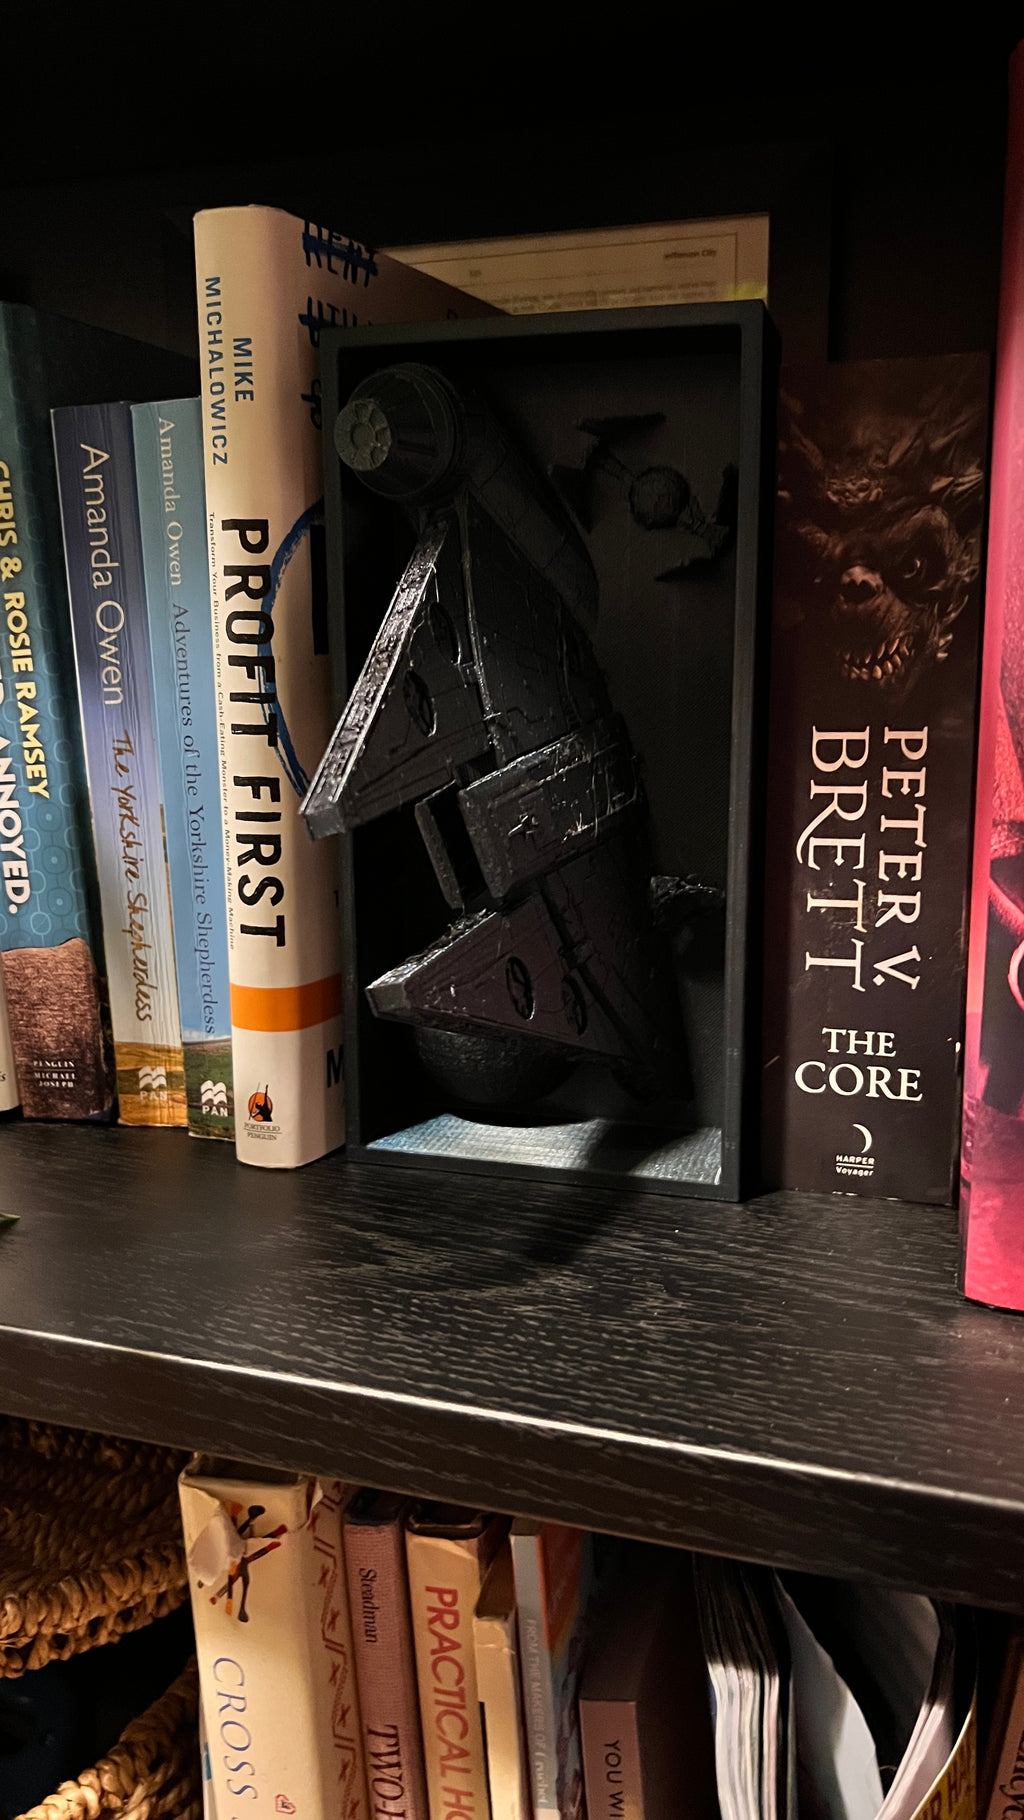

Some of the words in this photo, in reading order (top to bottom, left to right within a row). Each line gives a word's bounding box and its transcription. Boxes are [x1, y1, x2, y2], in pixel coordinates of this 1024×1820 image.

[204, 276, 228, 465] MICHALOWICZ
[233, 337, 254, 402] MIKE
[159, 417, 181, 513] Amanda
[80, 443, 120, 589] Amanda
[209, 511, 217, 568] Transform
[0, 556, 22, 583] &
[166, 521, 183, 586] Owen
[4, 591, 34, 673] ROSIE
[96, 600, 125, 705] Owen
[221, 519, 279, 748] PROFIT
[173, 604, 192, 727] Adventures
[15, 681, 50, 799] RAMSEY
[111, 729, 135, 778] The
[184, 735, 200, 759] of
[186, 763, 201, 796] the
[111, 784, 145, 884] Yorkshire
[190, 806, 210, 905] Yorkshire
[796, 725, 870, 992] BRETT
[875, 726, 928, 928] PETER
[233, 776, 286, 947] FIRST
[121, 890, 158, 1022] Shepherdess
[195, 912, 218, 1034] Shepherdess
[872, 945, 922, 990] V.
[33, 1060, 75, 1068] PENGUIN
[822, 1027, 897, 1057] THE
[34, 1072, 76, 1080] MICHAEL
[139, 1090, 167, 1101] PAN
[794, 1061, 923, 1102] CORE
[202, 1105, 228, 1117] PAN
[244, 1121, 281, 1132] PORTFOLIO
[247, 1132, 278, 1141] PENGUIN
[836, 1155, 875, 1165] HARPER
[836, 1165, 874, 1177] Voyager
[360, 1567, 380, 1643] Steadman
[425, 1585, 473, 1778] PRACTICAL
[213, 1657, 258, 1799] CROSS
[604, 1740, 622, 1783] YOU
[442, 1785, 475, 1820] H
